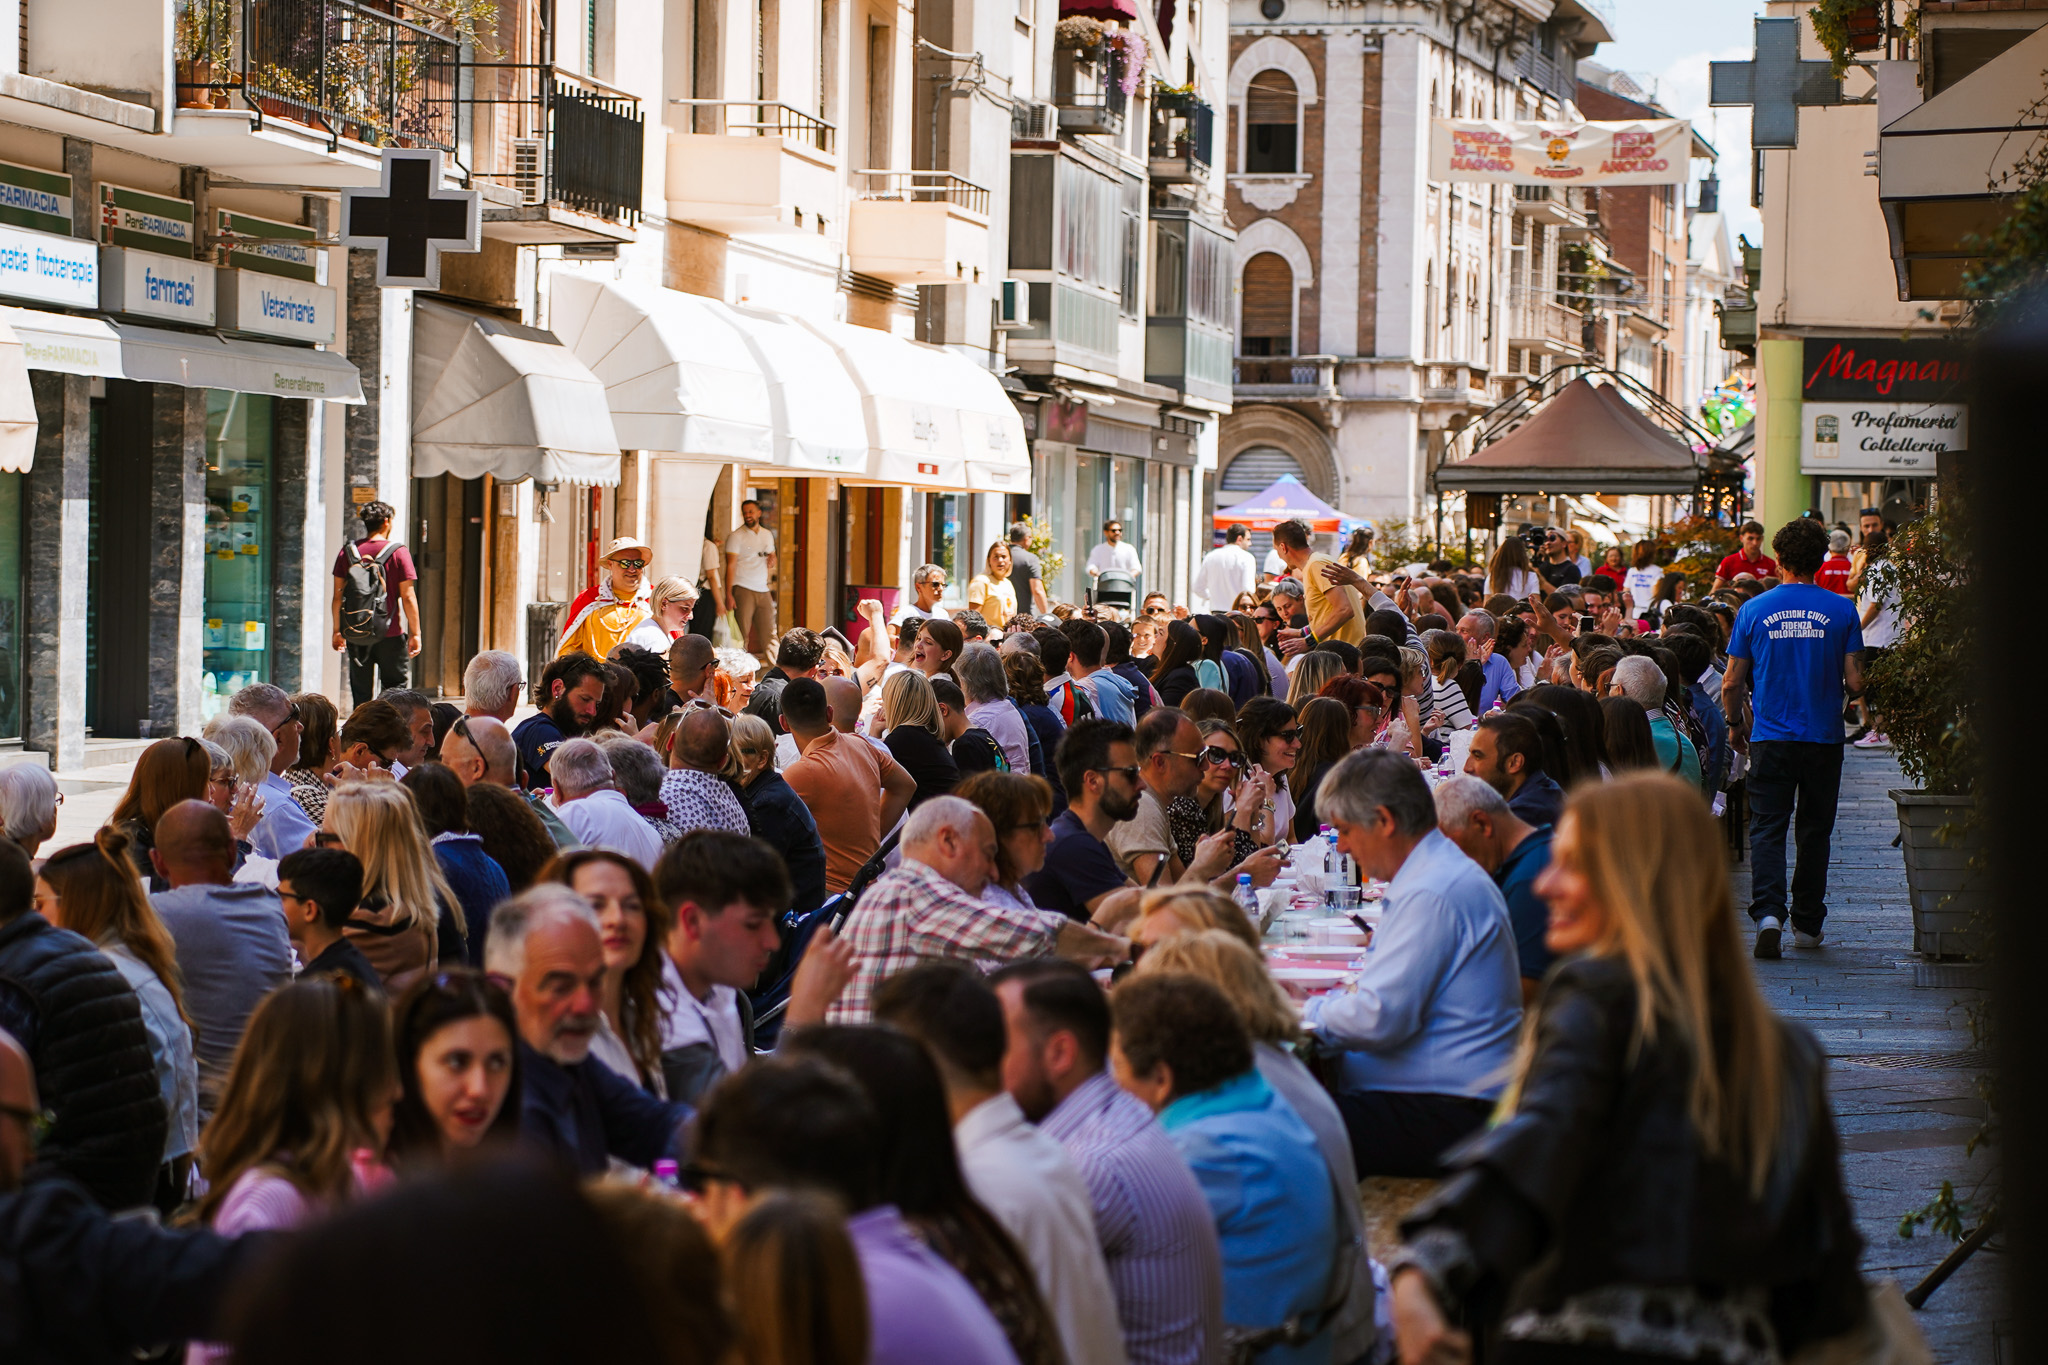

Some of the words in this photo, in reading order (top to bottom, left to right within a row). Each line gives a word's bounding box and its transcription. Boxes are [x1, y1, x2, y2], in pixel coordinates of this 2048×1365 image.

[1450, 157, 1515, 172] MAGGIO
[125, 213, 187, 239] ParaFARMACIA
[36, 247, 94, 289] fitoterapia
[145, 267, 196, 308] farmaci
[261, 290, 316, 325] Veterinaria
[1852, 411, 1958, 434] Profumeria
[1860, 437, 1949, 452] Coltelleria
[1763, 610, 1806, 628] PROTEZIONE
[1808, 610, 1831, 626] CIVILE
[1781, 621, 1812, 630] FIDENZA
[1769, 629, 1825, 639] VOLONTARIATO
